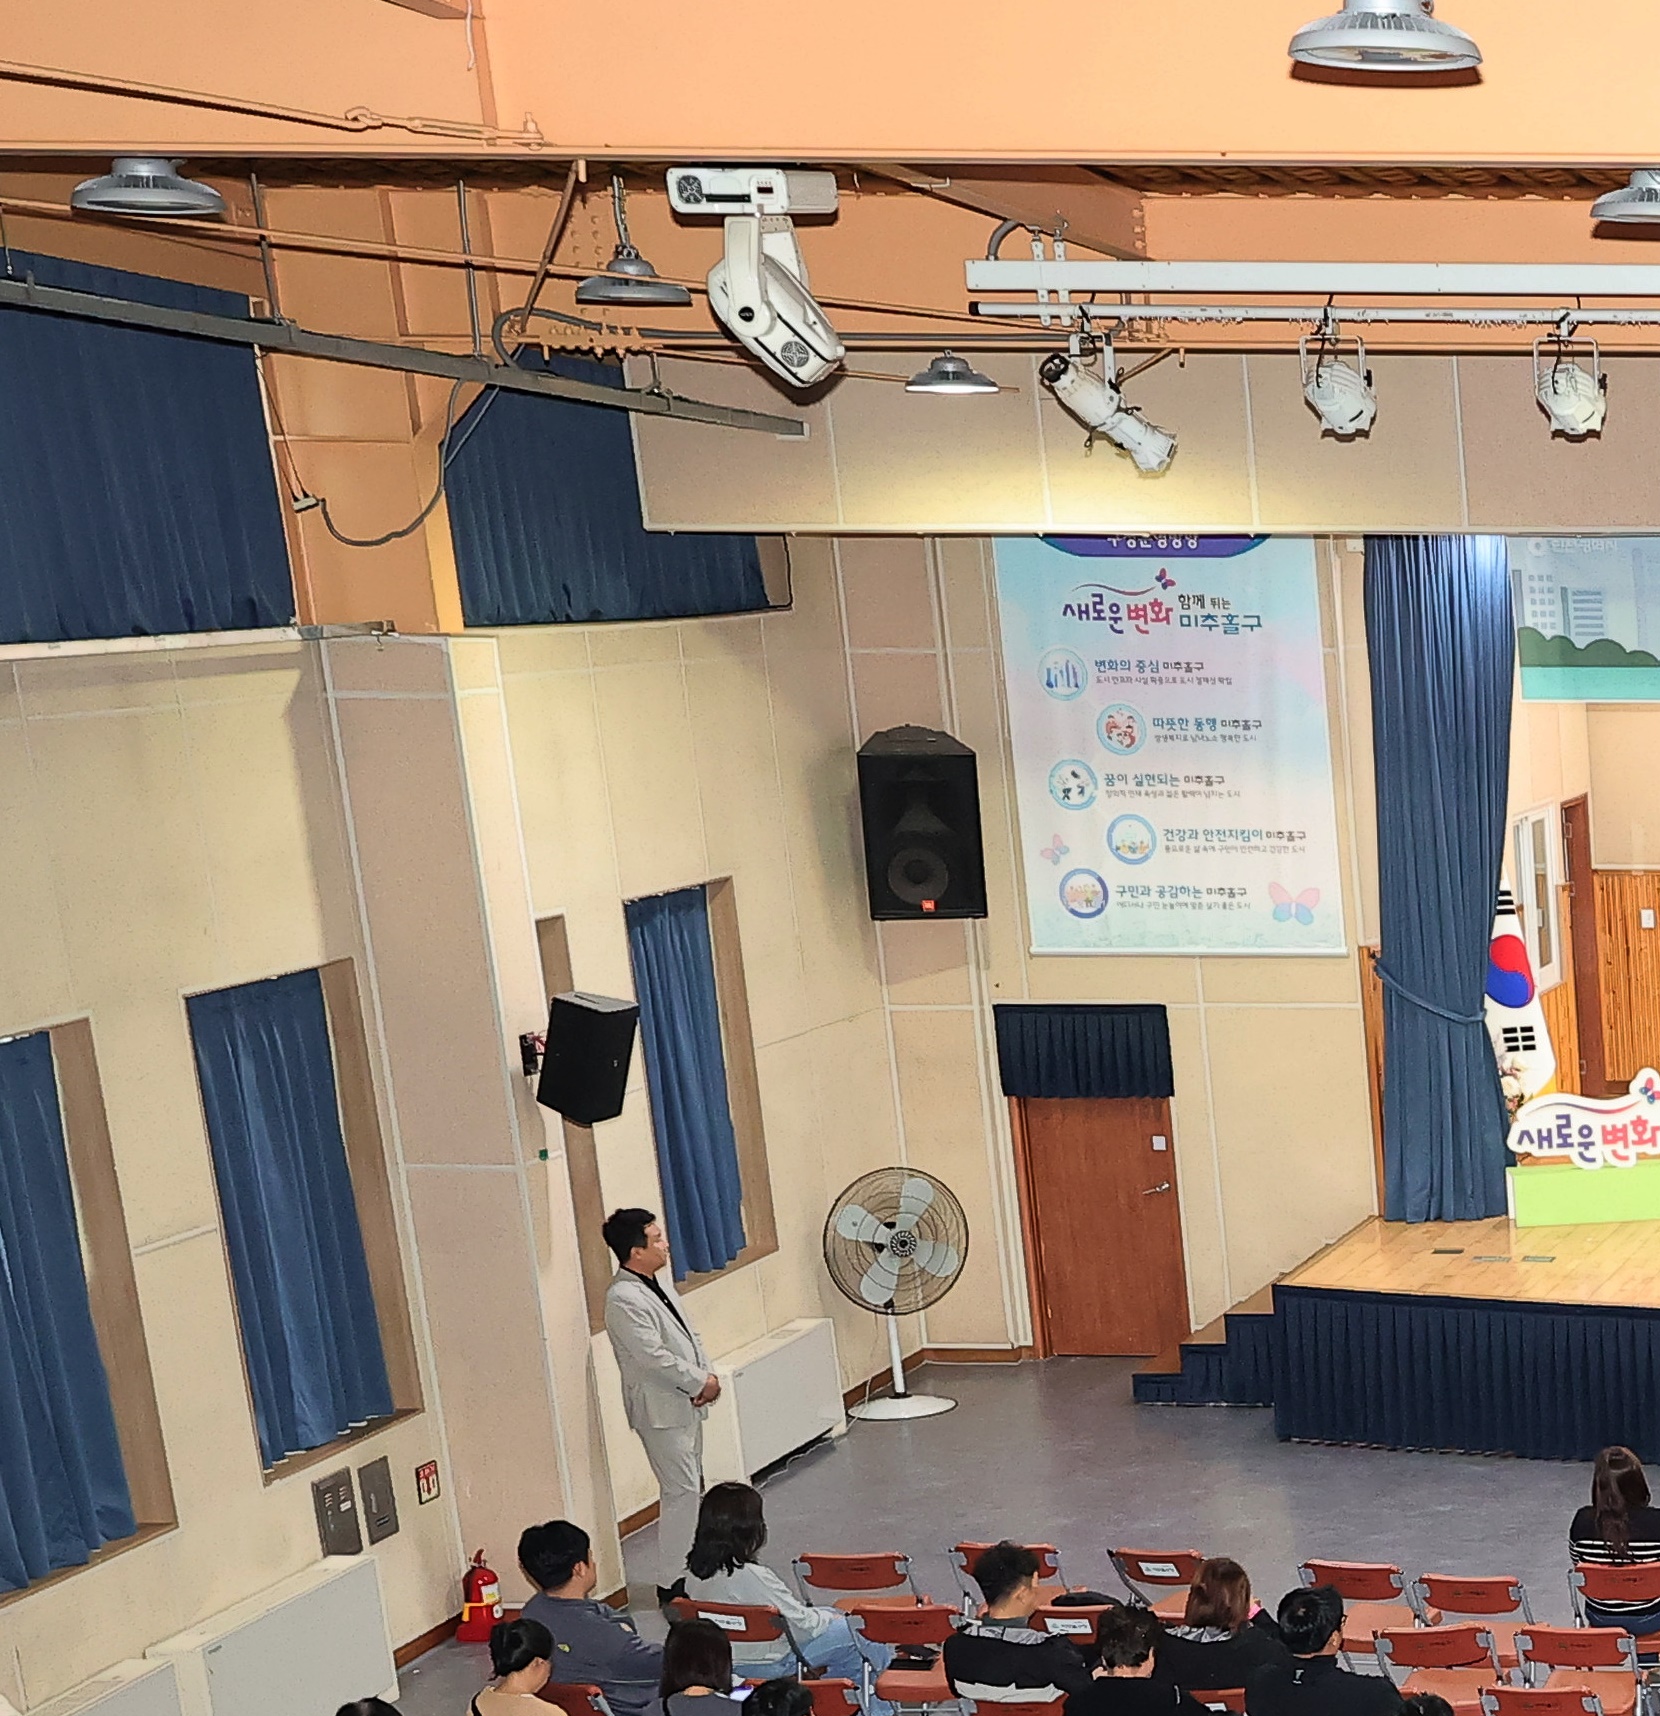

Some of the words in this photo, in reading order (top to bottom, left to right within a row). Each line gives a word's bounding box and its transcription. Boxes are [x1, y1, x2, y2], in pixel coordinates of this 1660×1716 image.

[1178, 593, 1206, 610] 함께
[1210, 597, 1231, 610] 뛰는
[1062, 592, 1124, 635] 새로운
[1126, 598, 1173, 635] 변화
[1179, 614, 1263, 635] 미추홀구
[1094, 659, 1131, 672] 변화의
[1135, 660, 1159, 673] 중심
[1163, 662, 1204, 673] 미추홀구
[1152, 717, 1189, 731] 따뜻한
[1193, 718, 1217, 732] 동행
[1221, 719, 1262, 730] 미추홀구
[1104, 774, 1128, 786] 꿈이
[1132, 774, 1180, 787] 실현되는
[1184, 775, 1225, 786] 미추홀구
[1163, 828, 1199, 842] 건강과
[1202, 828, 1263, 842] 안전지킴이
[1266, 830, 1306, 841] 미추홀구
[1115, 885, 1151, 897] 구민과
[1155, 885, 1203, 898] 공감하는
[1206, 888, 1247, 898] 미추홀구
[1517, 1113, 1596, 1160] 새로운
